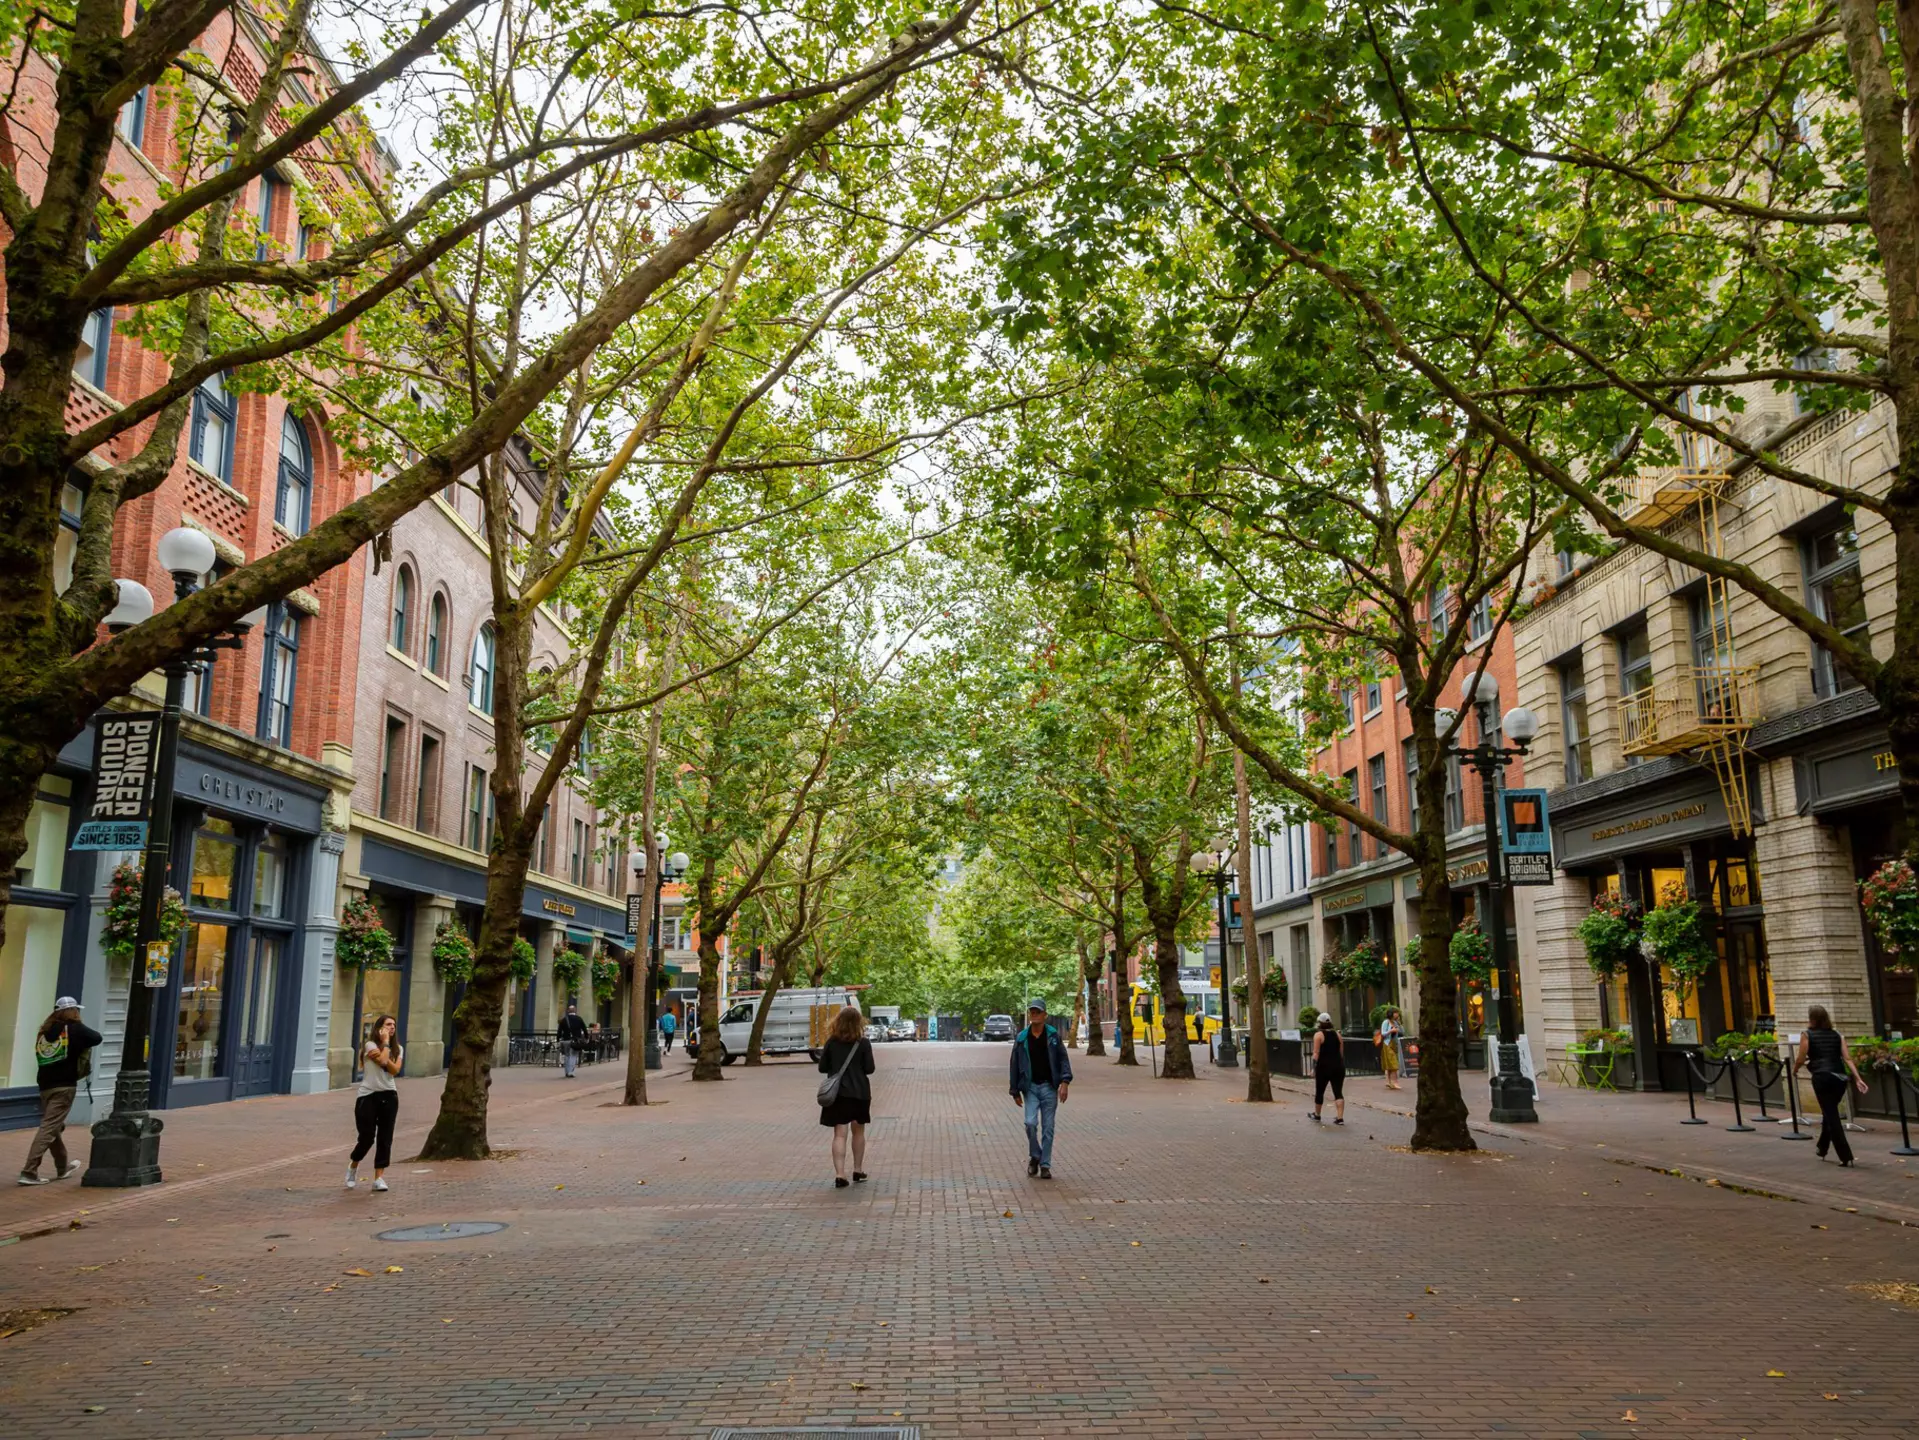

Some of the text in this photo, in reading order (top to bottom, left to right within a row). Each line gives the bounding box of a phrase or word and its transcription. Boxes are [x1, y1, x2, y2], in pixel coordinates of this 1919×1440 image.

[91, 721, 127, 817] SQUARE
[115, 720, 153, 816] PIONEER
[1872, 751, 1899, 770] TH
[79, 832, 141, 845] SINCE 1852
[1508, 855, 1549, 865] SEATTLE'S
[1509, 864, 1550, 875] ORIGINAL
[628, 897, 639, 933] SQUARE
